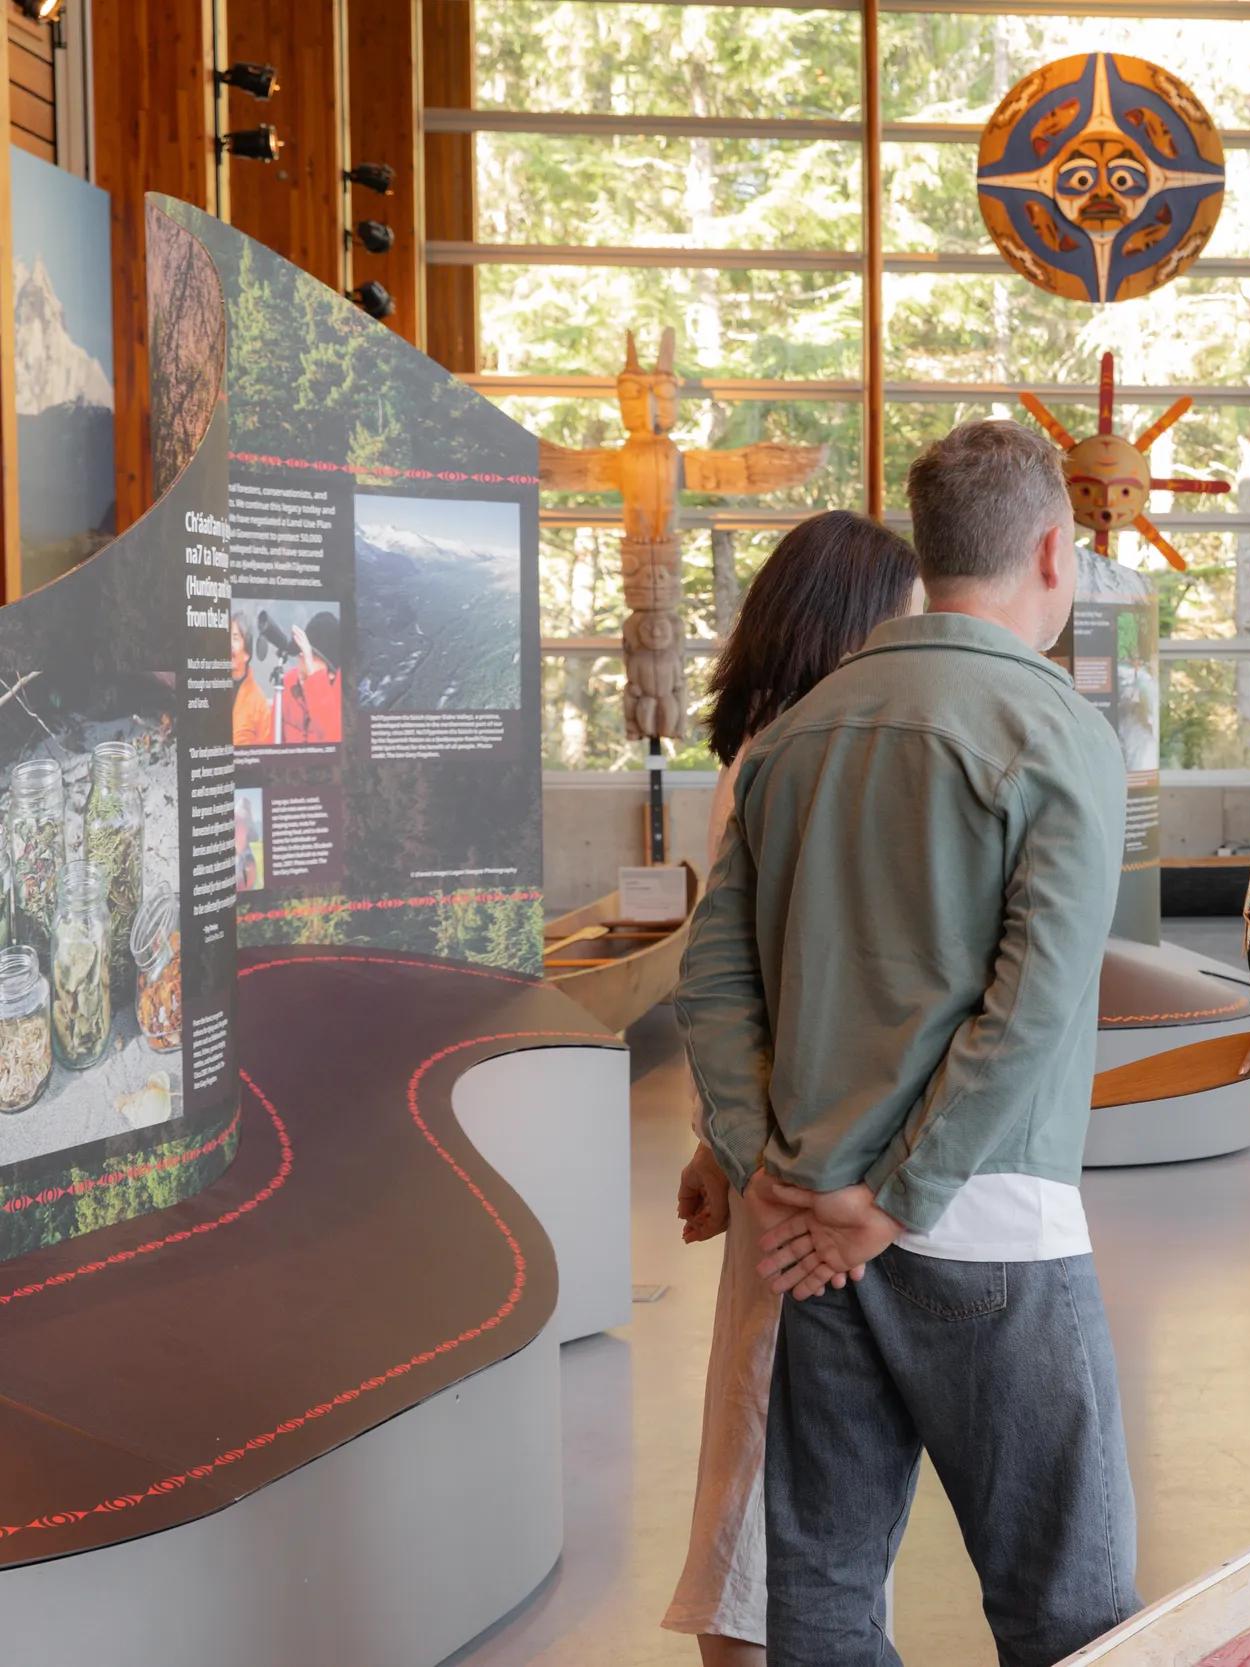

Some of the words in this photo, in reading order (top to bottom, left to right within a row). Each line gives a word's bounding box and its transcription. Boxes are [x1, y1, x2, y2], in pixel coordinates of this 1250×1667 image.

[314, 491, 328, 501] and
[245, 501, 270, 511] continue
[282, 503, 302, 515] legacy
[302, 505, 321, 517] today
[322, 506, 336, 516] and
[286, 518, 303, 528] Land
[303, 519, 316, 529] Use
[316, 520, 333, 530] Plan
[187, 605, 207, 627] from
